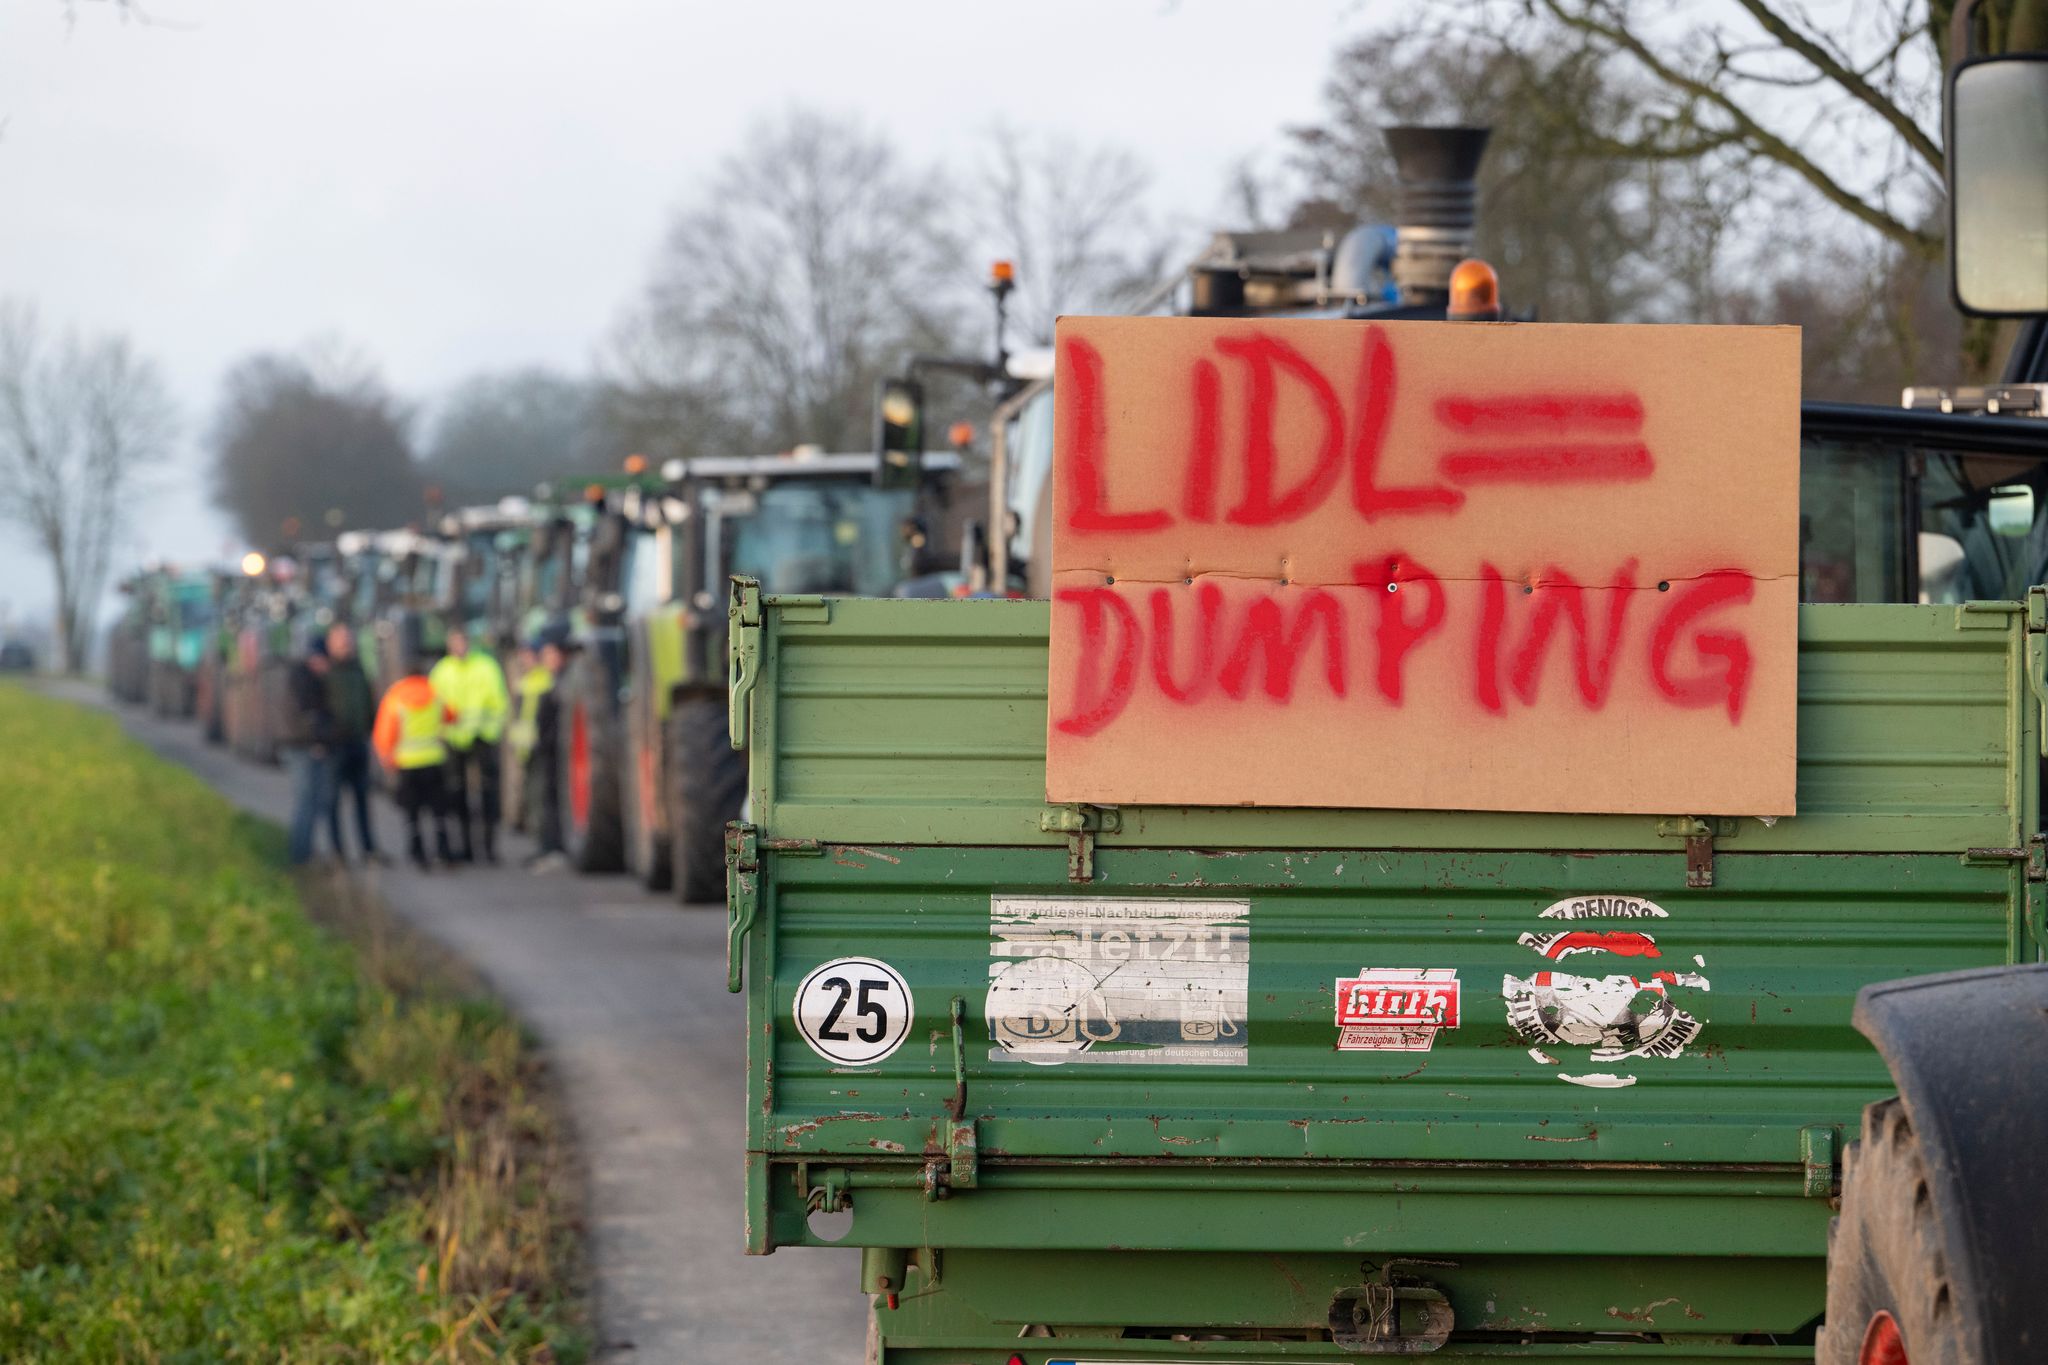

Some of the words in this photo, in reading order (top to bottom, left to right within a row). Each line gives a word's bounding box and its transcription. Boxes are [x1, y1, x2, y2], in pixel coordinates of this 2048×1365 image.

[1057, 555, 1756, 738] DUMPING
[818, 976, 889, 1043] 25
[1148, 1048, 1163, 1057] der
[1165, 1048, 1210, 1057] deutschen
[1212, 1048, 1243, 1057] Bauern
[1346, 1034, 1397, 1046] Fahrzeugbau
